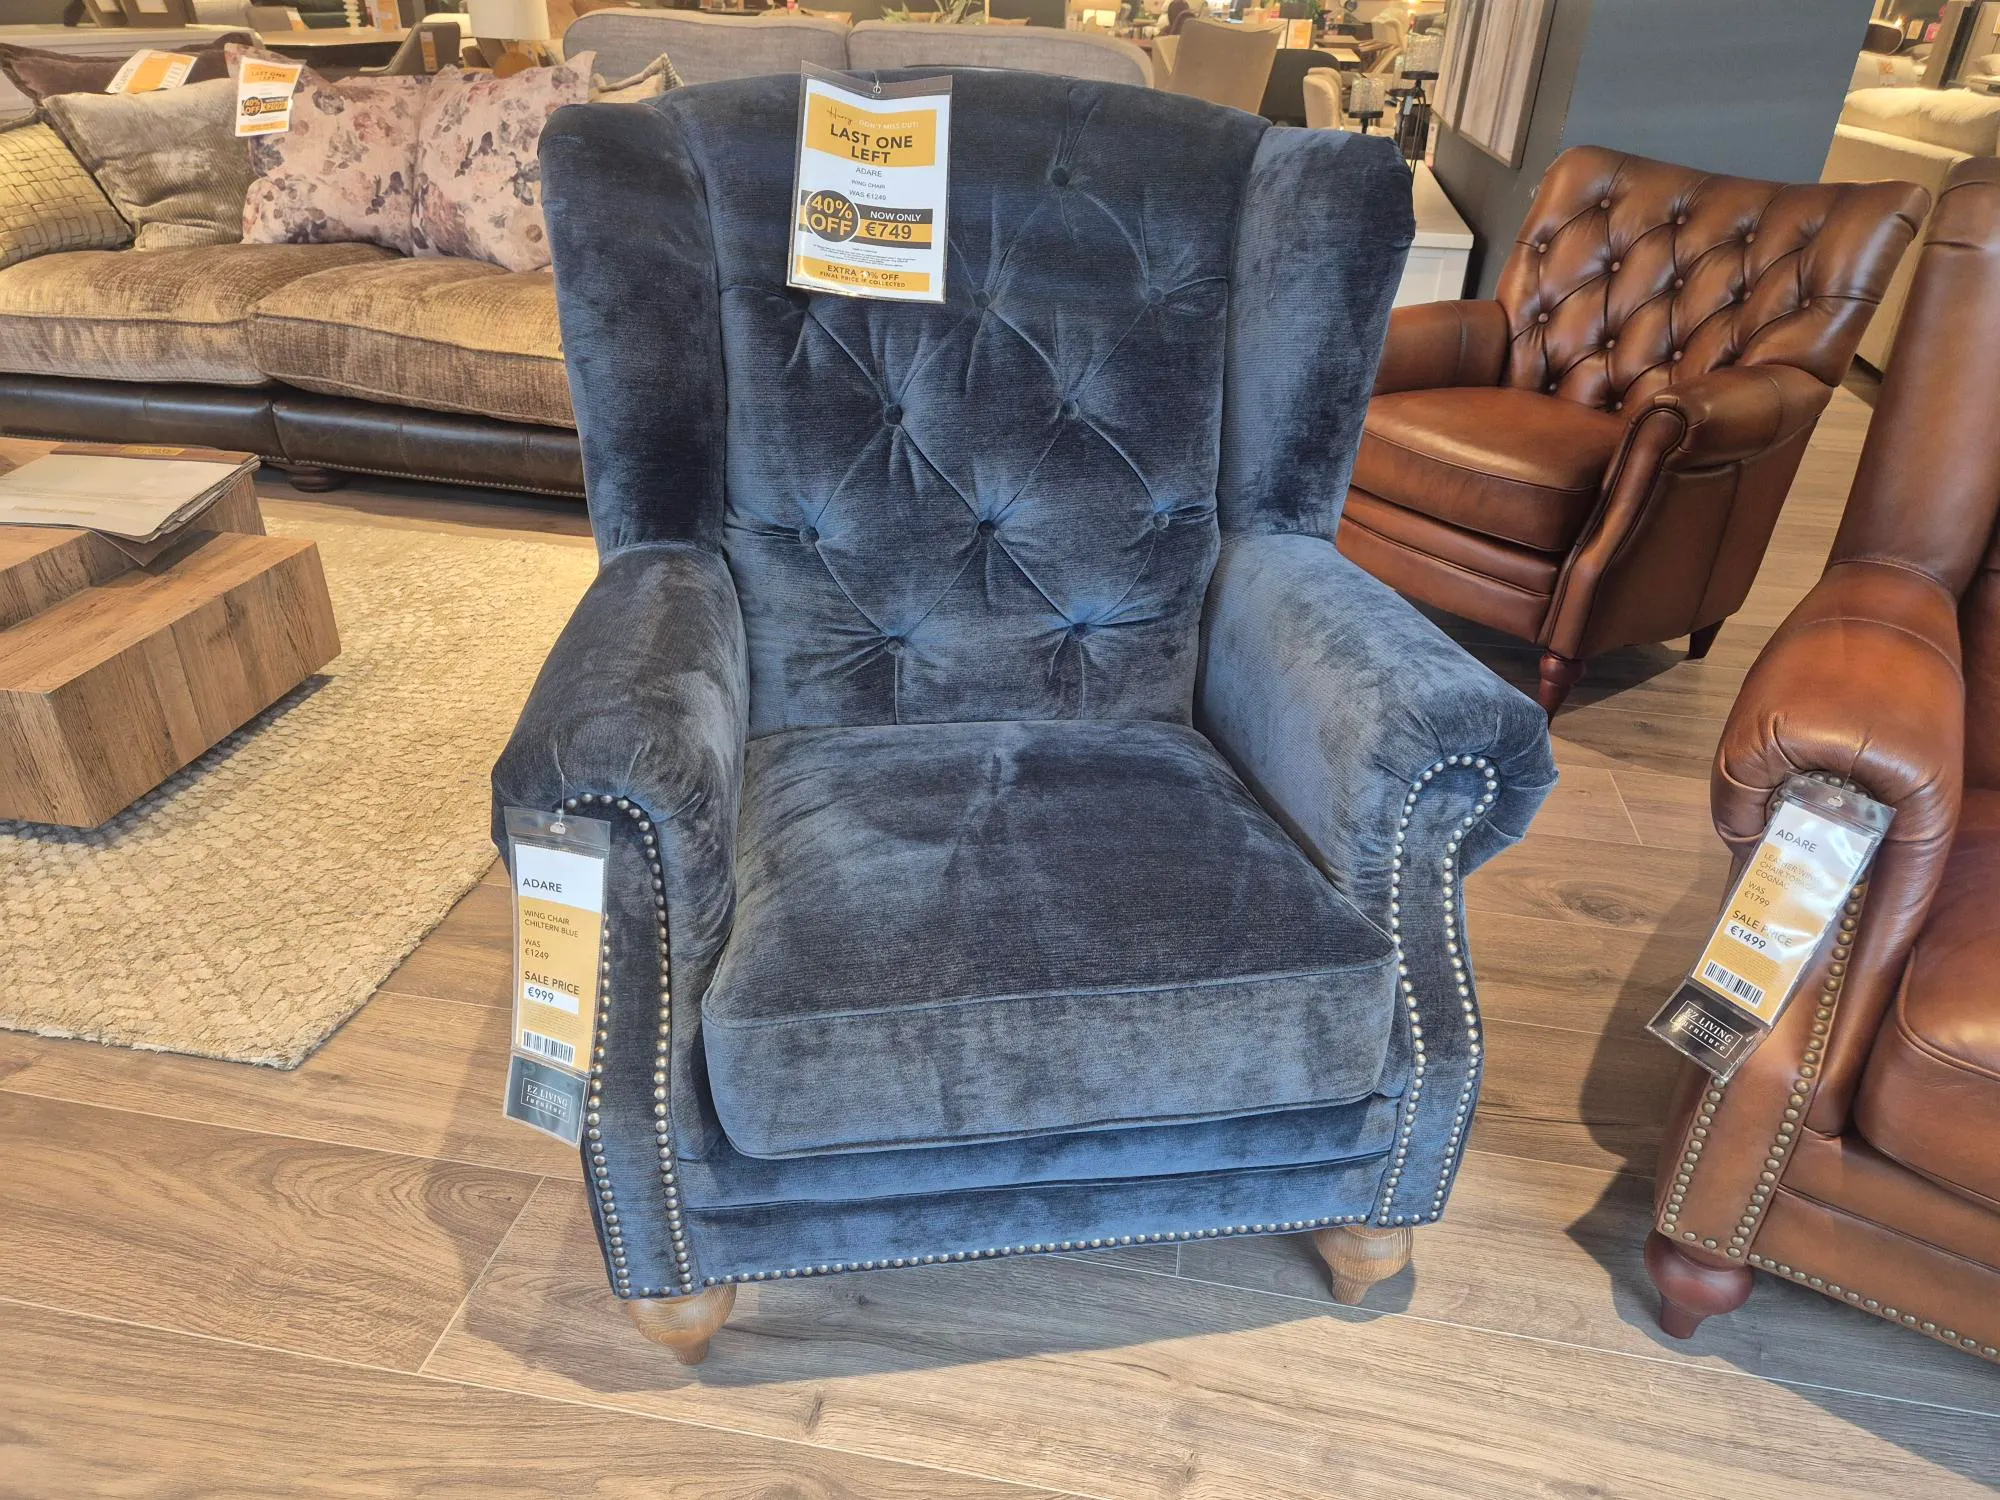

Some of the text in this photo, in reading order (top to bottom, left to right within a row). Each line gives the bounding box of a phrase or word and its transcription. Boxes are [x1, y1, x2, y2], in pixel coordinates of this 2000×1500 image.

[830, 123, 913, 149] LAST ONE
[851, 145, 891, 164] LEFT
[855, 167, 883, 178] ADARE
[849, 190, 887, 200] WAS €1249
[811, 195, 853, 219] 40%
[870, 210, 922, 222] NOW ONLY
[810, 213, 853, 236] OFF
[865, 221, 912, 240] €749
[820, 271, 839, 280] FINAL
[840, 275, 859, 283] PRICE
[868, 279, 906, 288] COLLECTED
[827, 264, 857, 277] EXTRA
[881, 273, 900, 281] OFF
[1775, 828, 1818, 853] ADARE
[1760, 861, 1784, 877] CHAIR
[522, 877, 562, 893] ADARE
[1748, 881, 1766, 895] WAS
[1744, 890, 1770, 907] €1799
[523, 909, 570, 925] WING CHAIR
[1732, 910, 1760, 930] SALE
[524, 918, 579, 938] CHILTERN BLUE
[1730, 925, 1767, 950] €1499
[524, 938, 541, 948] WAS
[524, 947, 550, 960] €1249
[524, 970, 580, 996] SALE PRICE
[528, 986, 555, 1003] €999
[1679, 1016, 1726, 1051] urniture
[1698, 1017, 1734, 1043] LIVING
[527, 1084, 568, 1107] EZ LIVING
[526, 1095, 567, 1118] furniture
